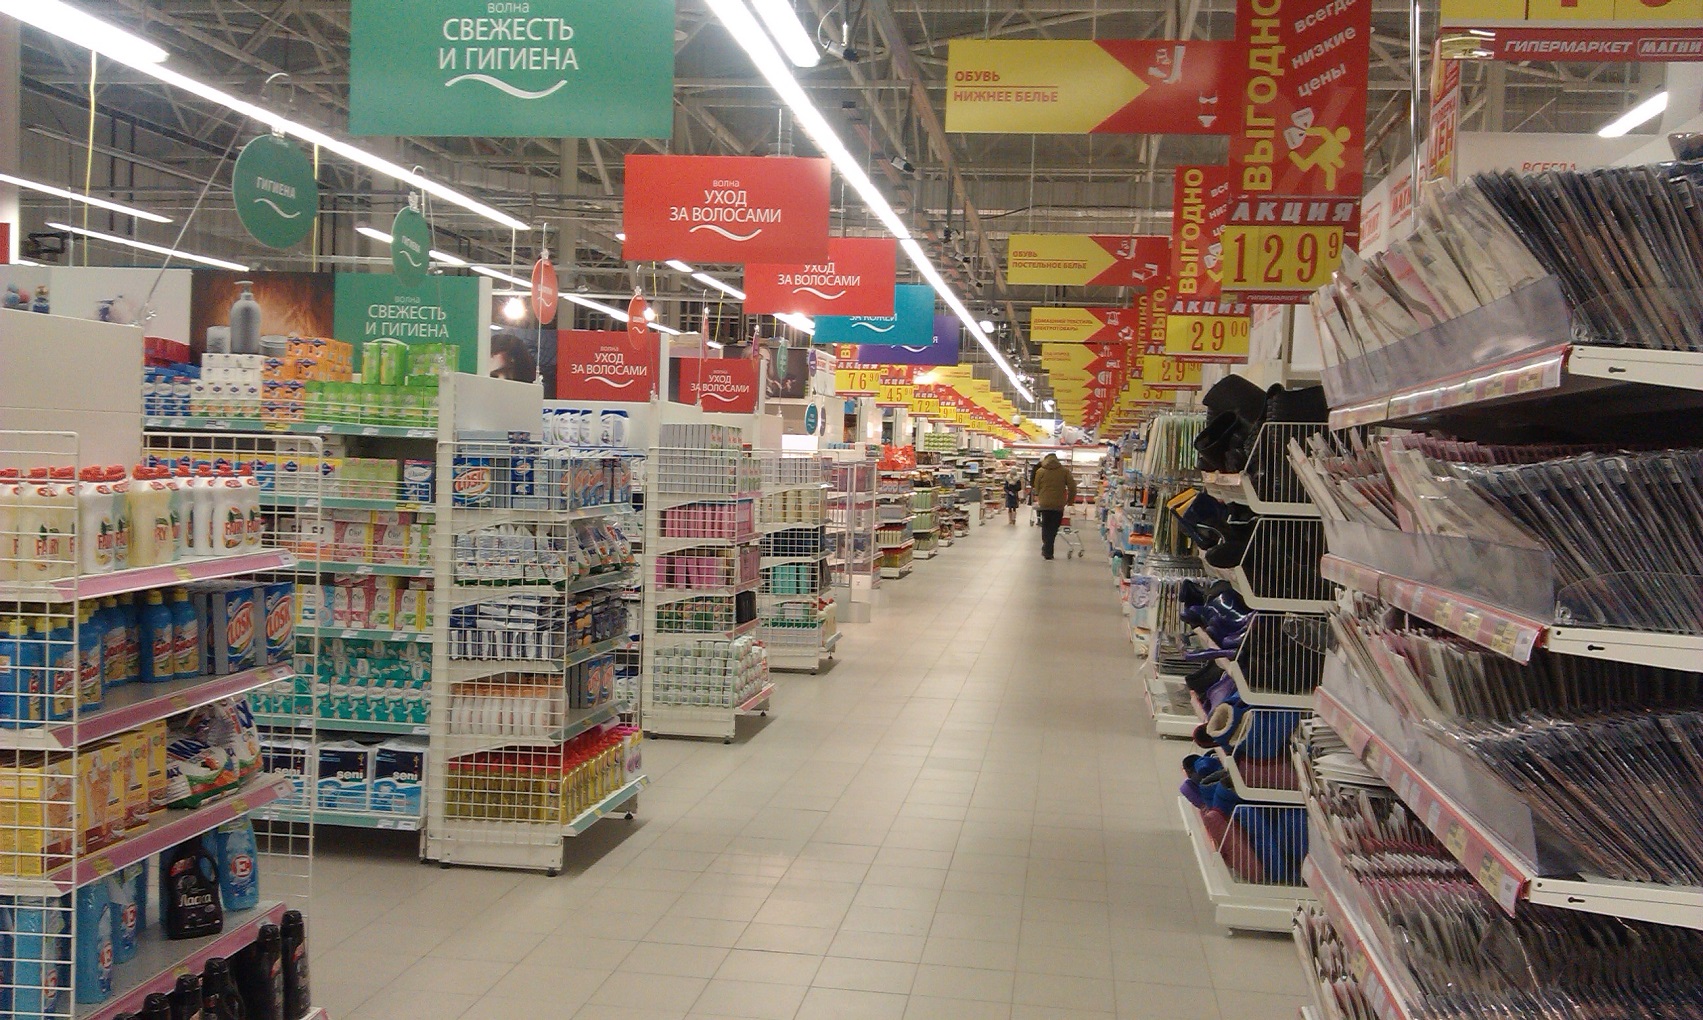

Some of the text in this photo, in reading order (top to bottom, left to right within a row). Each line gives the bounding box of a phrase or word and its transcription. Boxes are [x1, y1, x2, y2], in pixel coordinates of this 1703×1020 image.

[487, 2, 530, 13] волна
[442, 17, 575, 41] СВЕЖЕСТЬ
[1290, 26, 1356, 69] низкие
[1504, 40, 1703, 54] ГИПЕРМАРКЕТ МАГНИ
[438, 47, 580, 70] И ГИГИЕНА
[954, 70, 1001, 82] ОБУВЬ
[1297, 63, 1347, 98] цены
[953, 90, 1059, 103] НИЖНЕЕ БЕЛЬЕ
[1242, 0, 1286, 191] ВЫГОДНО
[255, 176, 297, 200] ГИГИЕНА
[712, 180, 740, 188] волна
[703, 190, 748, 208] УХОД
[668, 206, 782, 223] ЗА ВОЛОСАМИ
[1230, 201, 1354, 224] АКЦИЯ
[1178, 168, 1206, 294] ВЫГОДНО
[1012, 250, 1039, 258] ОБУВЬ
[1012, 261, 1088, 270] ПОСТЕЛЬНОЕ БЕЛЬЕ
[777, 274, 861, 287] ЗА ВОЛОСАМИ
[367, 304, 448, 321] СВЕЖЕСТЬ
[1171, 300, 1248, 315] АКЦИЯ
[364, 321, 450, 338] И ГИГИЕНА
[594, 352, 624, 364] УХОД
[571, 363, 648, 377] ЗА ВОЛОСАМИ
[708, 374, 732, 385] УХОД
[689, 382, 750, 394] ЗА ВОЛОСАМИ
[228, 607, 253, 646] LOSK
[266, 602, 292, 640] LOSK
[336, 769, 364, 780] seni
[392, 770, 418, 781] seni
[178, 893, 213, 908] Ласка
